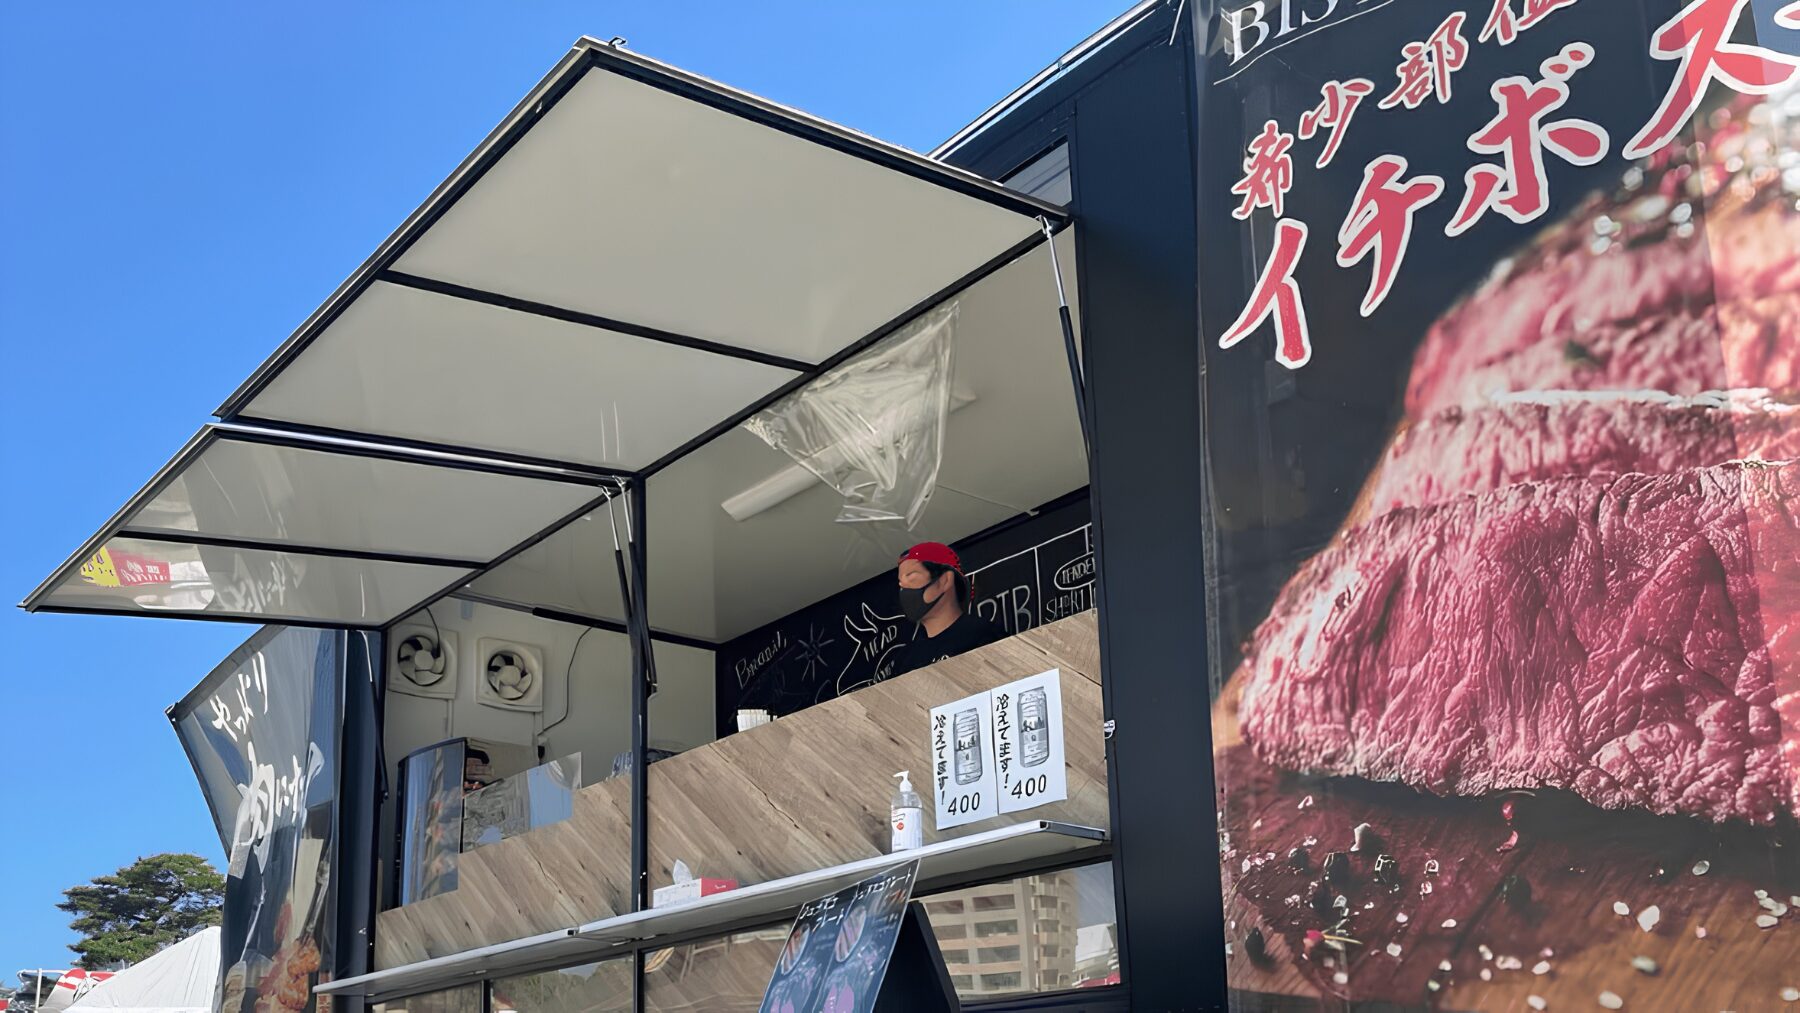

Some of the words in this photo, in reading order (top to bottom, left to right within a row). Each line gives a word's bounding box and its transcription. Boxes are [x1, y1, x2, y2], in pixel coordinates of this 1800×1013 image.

[1220, 0, 1376, 66] BIS
[1219, 0, 1800, 370] イチボス
[209, 651, 268, 742] やっぱり
[947, 792, 981, 816] 400
[1011, 774, 1047, 799] 400
